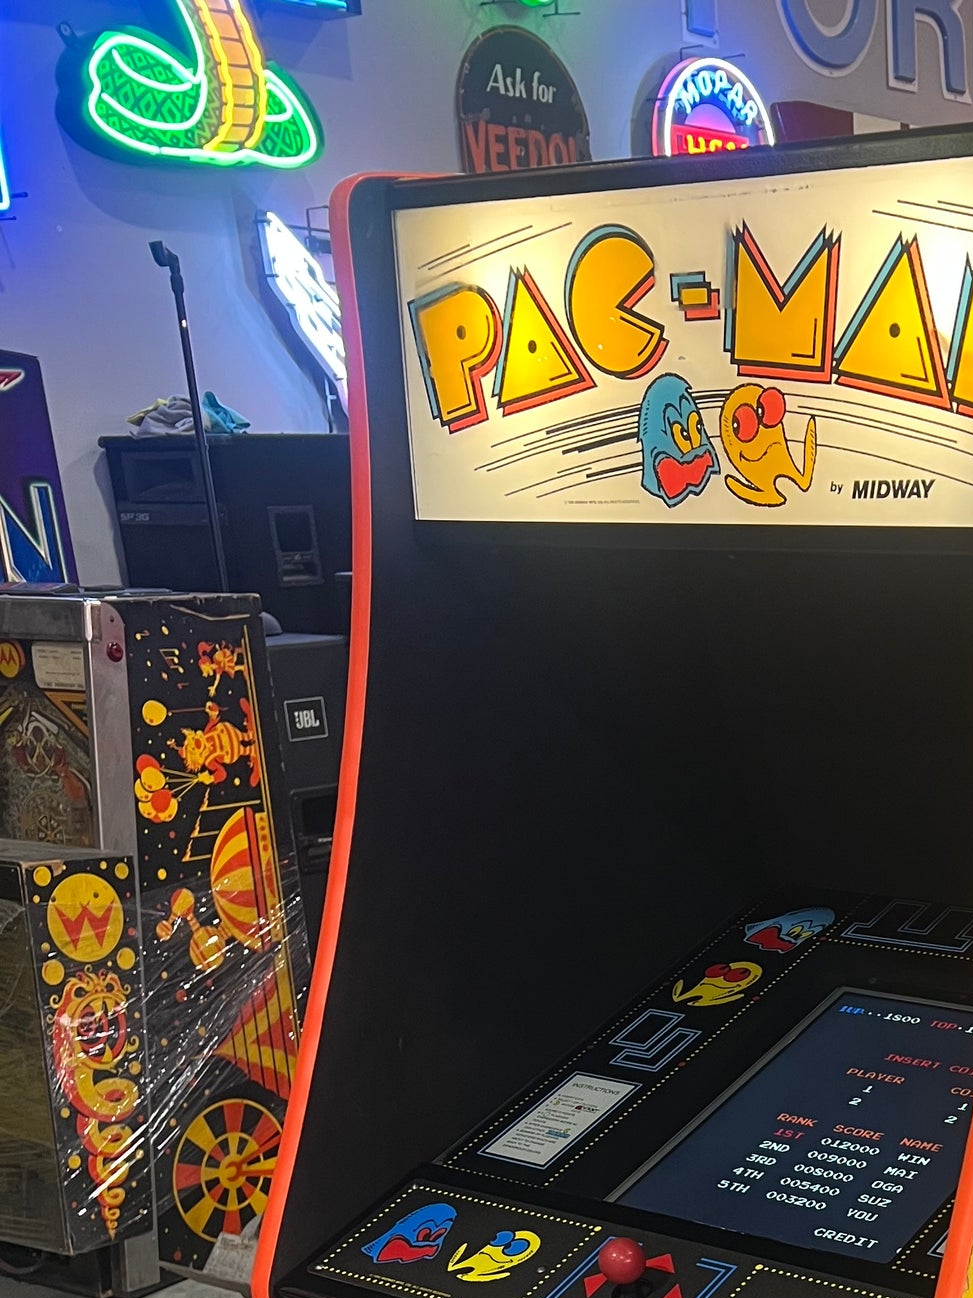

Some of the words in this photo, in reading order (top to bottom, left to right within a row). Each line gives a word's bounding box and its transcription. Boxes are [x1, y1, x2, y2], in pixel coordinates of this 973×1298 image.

[486, 63, 527, 99] Ask
[532, 71, 557, 103] for
[676, 69, 760, 125] MOPAR
[830, 481, 843, 494] by
[851, 478, 936, 500] MIDWAY
[294, 709, 320, 729] JBL
[930, 1019, 957, 1031] TOP
[884, 1053, 942, 1070] INSERT
[571, 1082, 621, 1097] INSTRUCTIONS
[846, 1067, 905, 1085] PLAYER
[848, 1097, 862, 1107] 2
[943, 1115, 958, 1125] 2
[862, 1085, 873, 1094] 1
[957, 1102, 968, 1112] 1
[776, 1112, 819, 1128] RANK
[833, 1124, 885, 1142] SCORE
[899, 1137, 944, 1153] NAME
[758, 1139, 791, 1154] 2ND
[807, 1150, 867, 1170] 009000
[883, 1166, 920, 1181] MAI
[773, 1128, 806, 1141] 1ST
[820, 1137, 881, 1156] 012000
[898, 1152, 932, 1167] WIN
[732, 1166, 765, 1181] 4TH
[780, 1176, 841, 1197] 005400
[857, 1193, 893, 1208] SUZ
[745, 1152, 778, 1167] 3RD
[793, 1163, 855, 1183] 008000
[871, 1180, 905, 1195] OGA
[717, 1179, 751, 1194] 5TH
[766, 1190, 827, 1211] 003200
[846, 1207, 879, 1223] YOU
[813, 1227, 880, 1250] CREDIT
